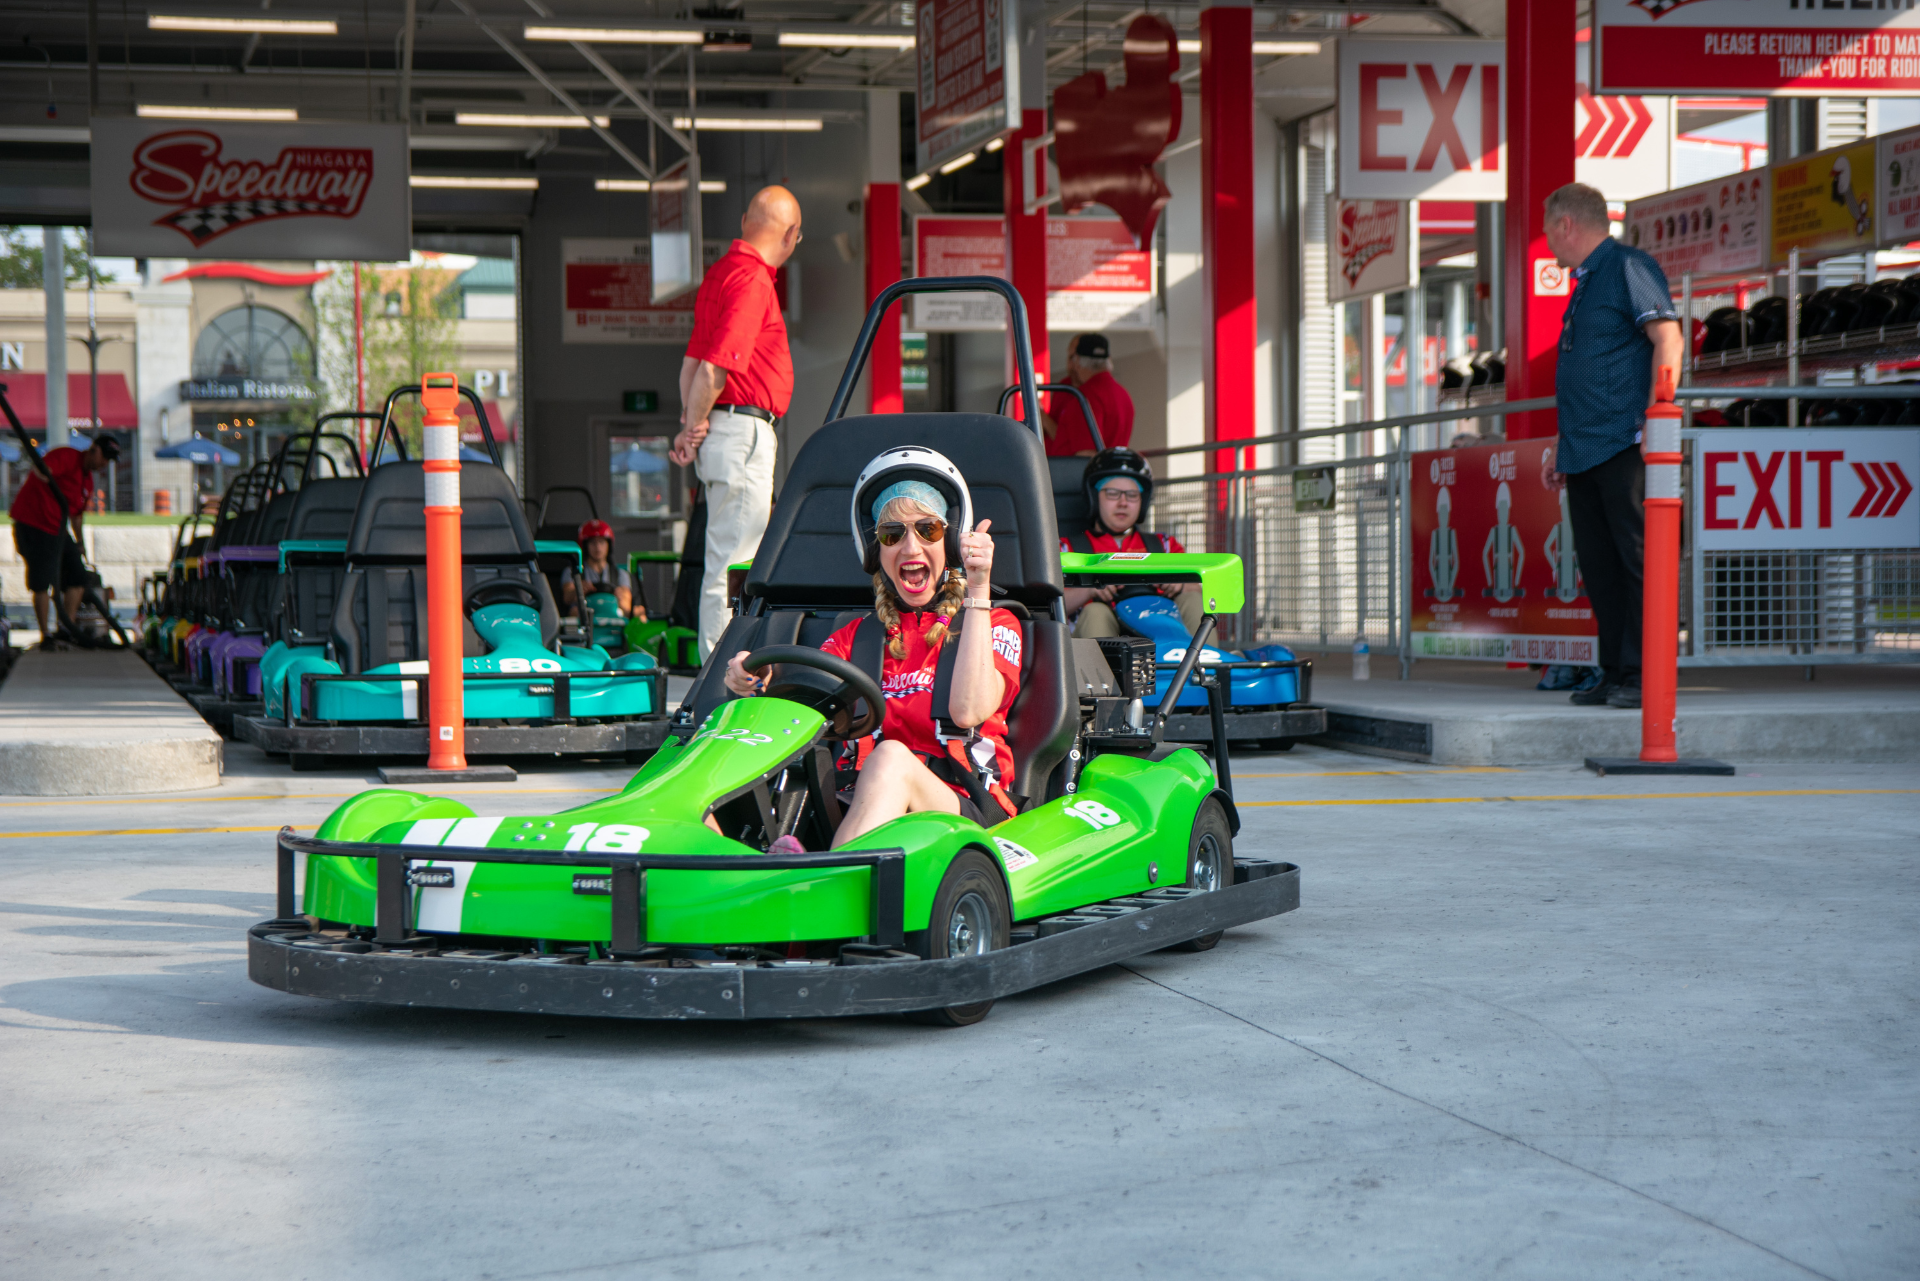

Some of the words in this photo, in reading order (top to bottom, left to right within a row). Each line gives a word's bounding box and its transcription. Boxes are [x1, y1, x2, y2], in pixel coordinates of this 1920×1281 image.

[1704, 33, 1755, 55] PLEASE
[1759, 33, 1812, 55] RETURN
[1815, 33, 1868, 55] HELMET
[1873, 34, 1890, 55] TO
[1778, 57, 1856, 78] THANK-YOU
[1860, 57, 1886, 78] FOR
[1890, 57, 1920, 78] RIDI
[1358, 62, 1499, 172] EXI
[296, 153, 368, 168] NIAGARA
[135, 134, 368, 212] Speedway
[189, 379, 239, 398] Italian
[1703, 450, 1844, 530] EXIT
[990, 624, 1021, 651] OMB
[1511, 640, 1526, 659] PULL
[1528, 640, 1540, 660] RED
[1541, 640, 1556, 660] TABS
[1558, 640, 1566, 660] TO
[1568, 641, 1592, 662] LOOSEN
[499, 658, 561, 672] 80
[882, 669, 934, 690] peedw
[1063, 800, 1121, 830] 18
[564, 822, 651, 854] 18
